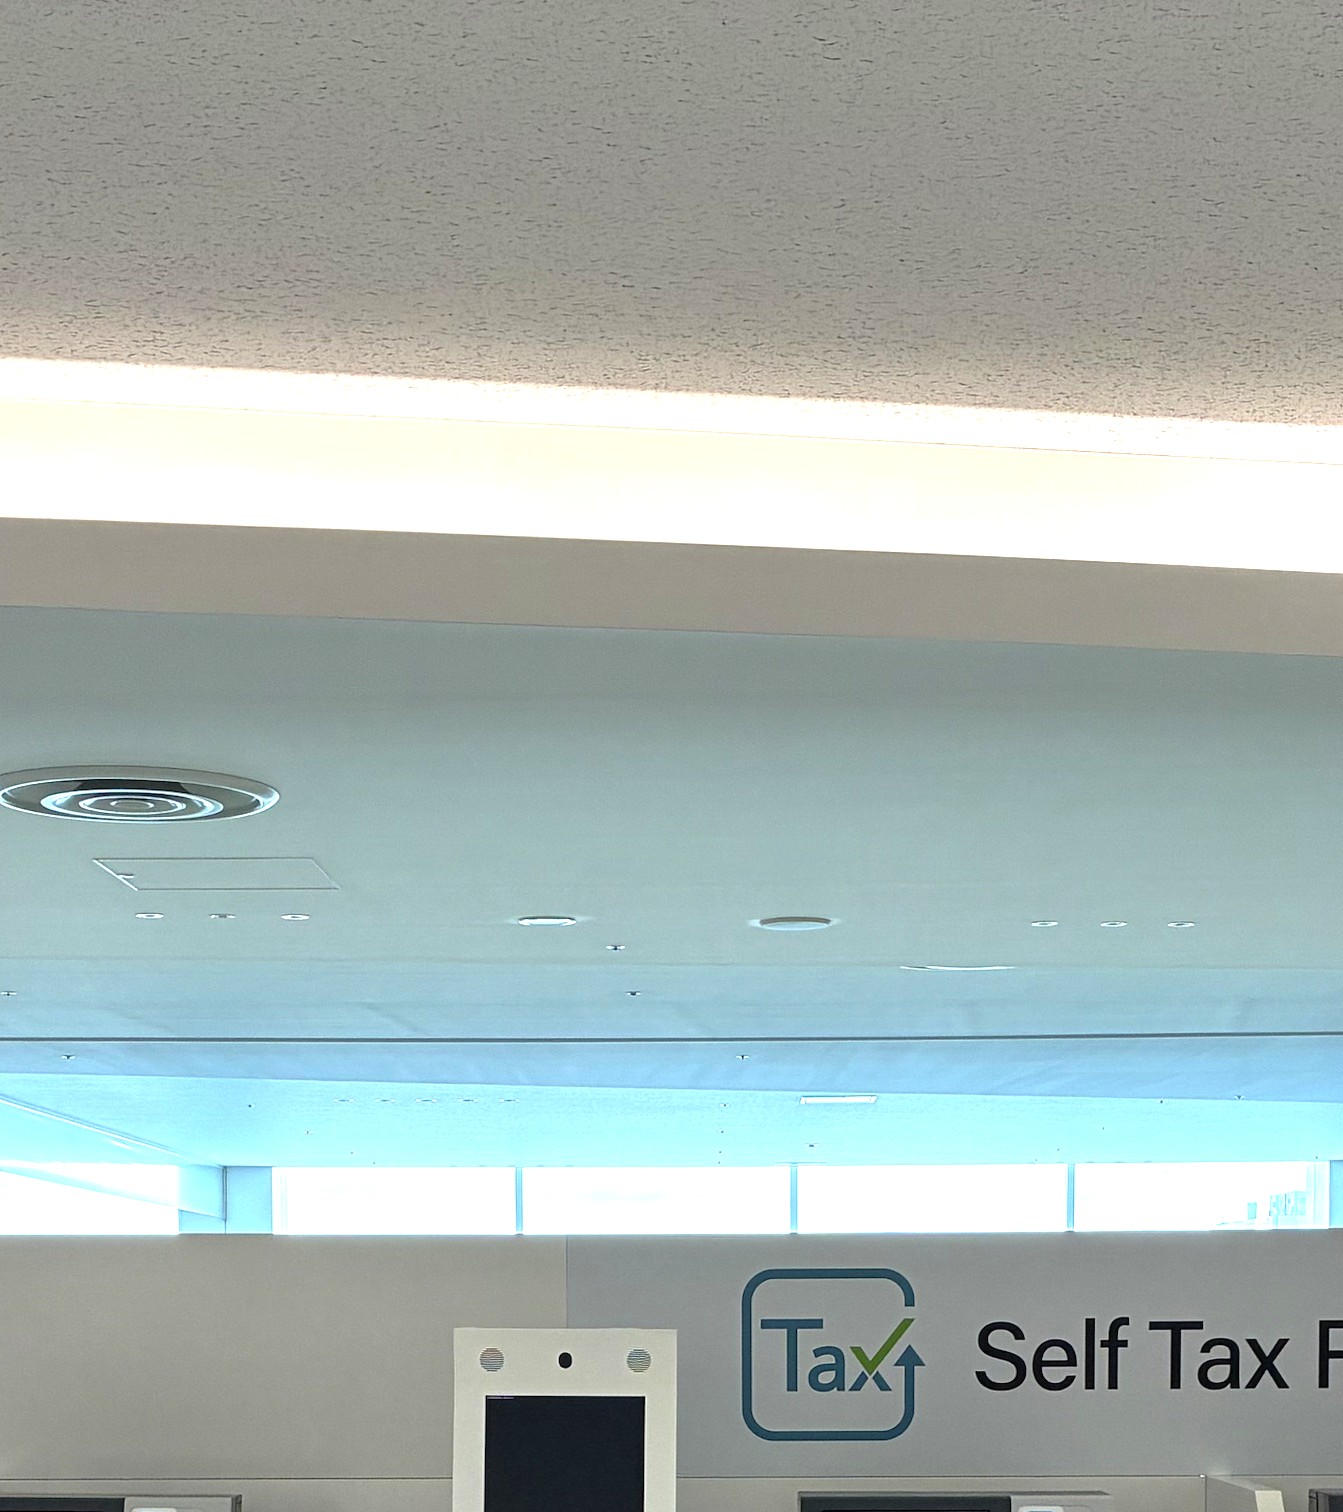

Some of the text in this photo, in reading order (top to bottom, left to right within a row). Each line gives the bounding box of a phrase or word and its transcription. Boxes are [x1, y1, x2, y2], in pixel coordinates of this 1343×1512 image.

[760, 1318, 915, 1393] Tax
[975, 1317, 1130, 1391] Self
[1149, 1321, 1290, 1390] Tax
